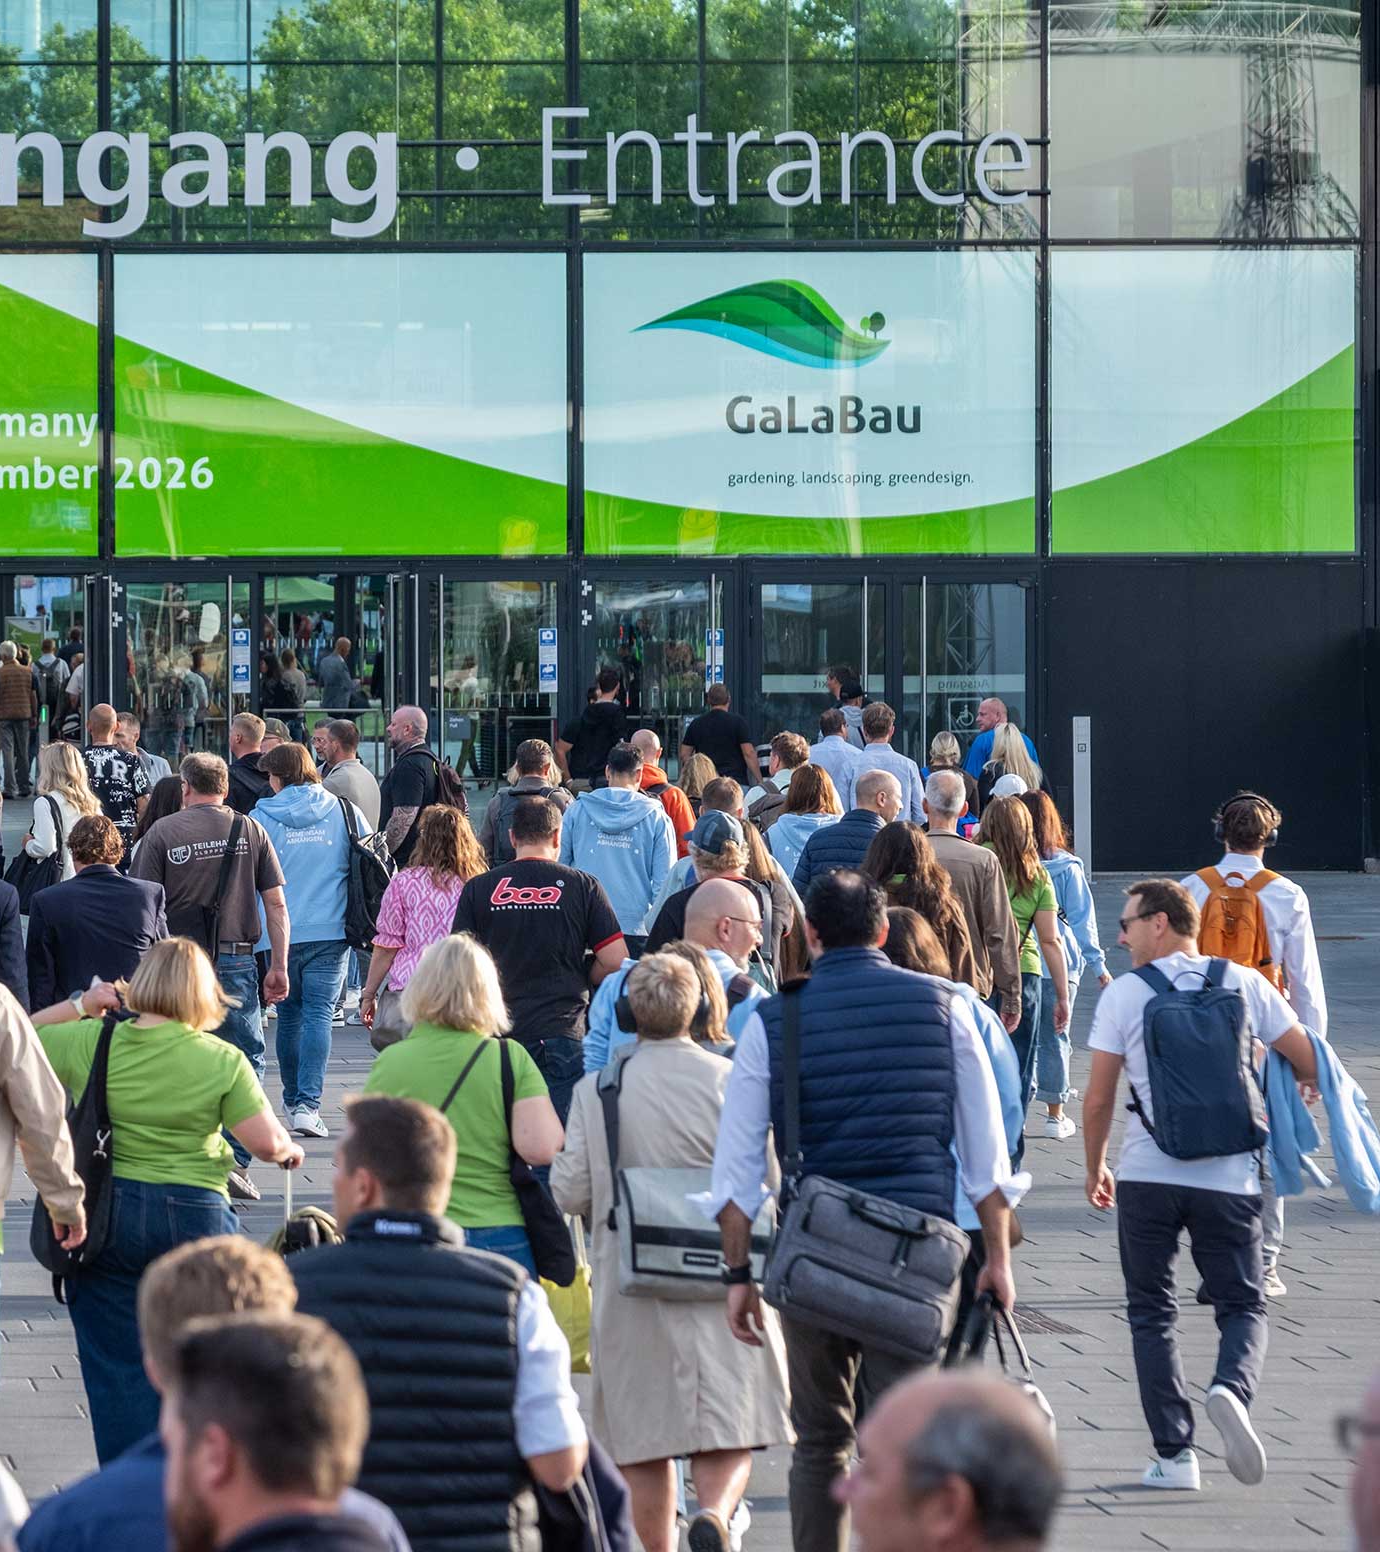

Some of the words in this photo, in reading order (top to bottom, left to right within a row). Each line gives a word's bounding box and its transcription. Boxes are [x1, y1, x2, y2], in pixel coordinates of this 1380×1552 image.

[541, 107, 1032, 206] Entrance
[725, 395, 921, 434] GaLaBau
[114, 456, 214, 489] 2026
[728, 472, 798, 487] gardening.
[802, 471, 885, 487] landscaping.
[889, 471, 975, 487] greendesign.
[193, 837, 248, 850] TEILEHAEL
